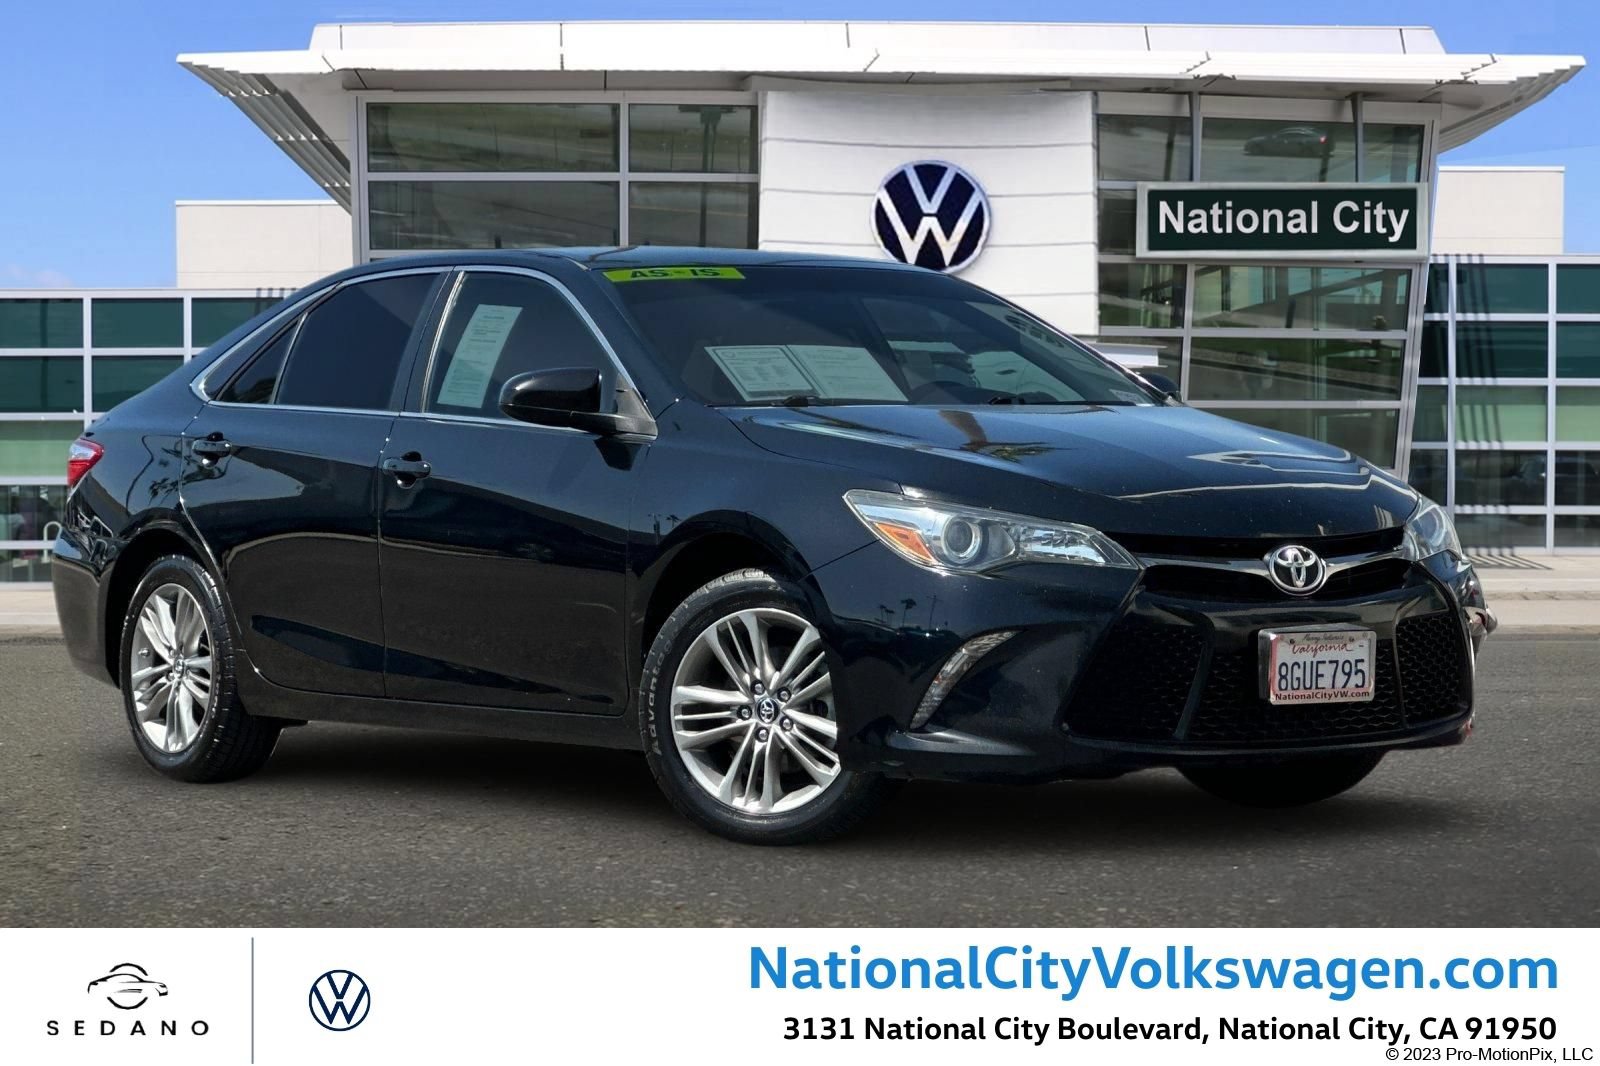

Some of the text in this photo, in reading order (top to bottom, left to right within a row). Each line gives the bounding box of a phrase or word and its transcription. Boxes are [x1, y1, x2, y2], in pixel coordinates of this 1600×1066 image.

[871, 160, 990, 273] VW
[1159, 200, 1410, 243] National City
[1292, 643, 1353, 658] California
[1278, 659, 1366, 691] 8GUE795
[1275, 690, 1370, 701] NationalCityVW.com
